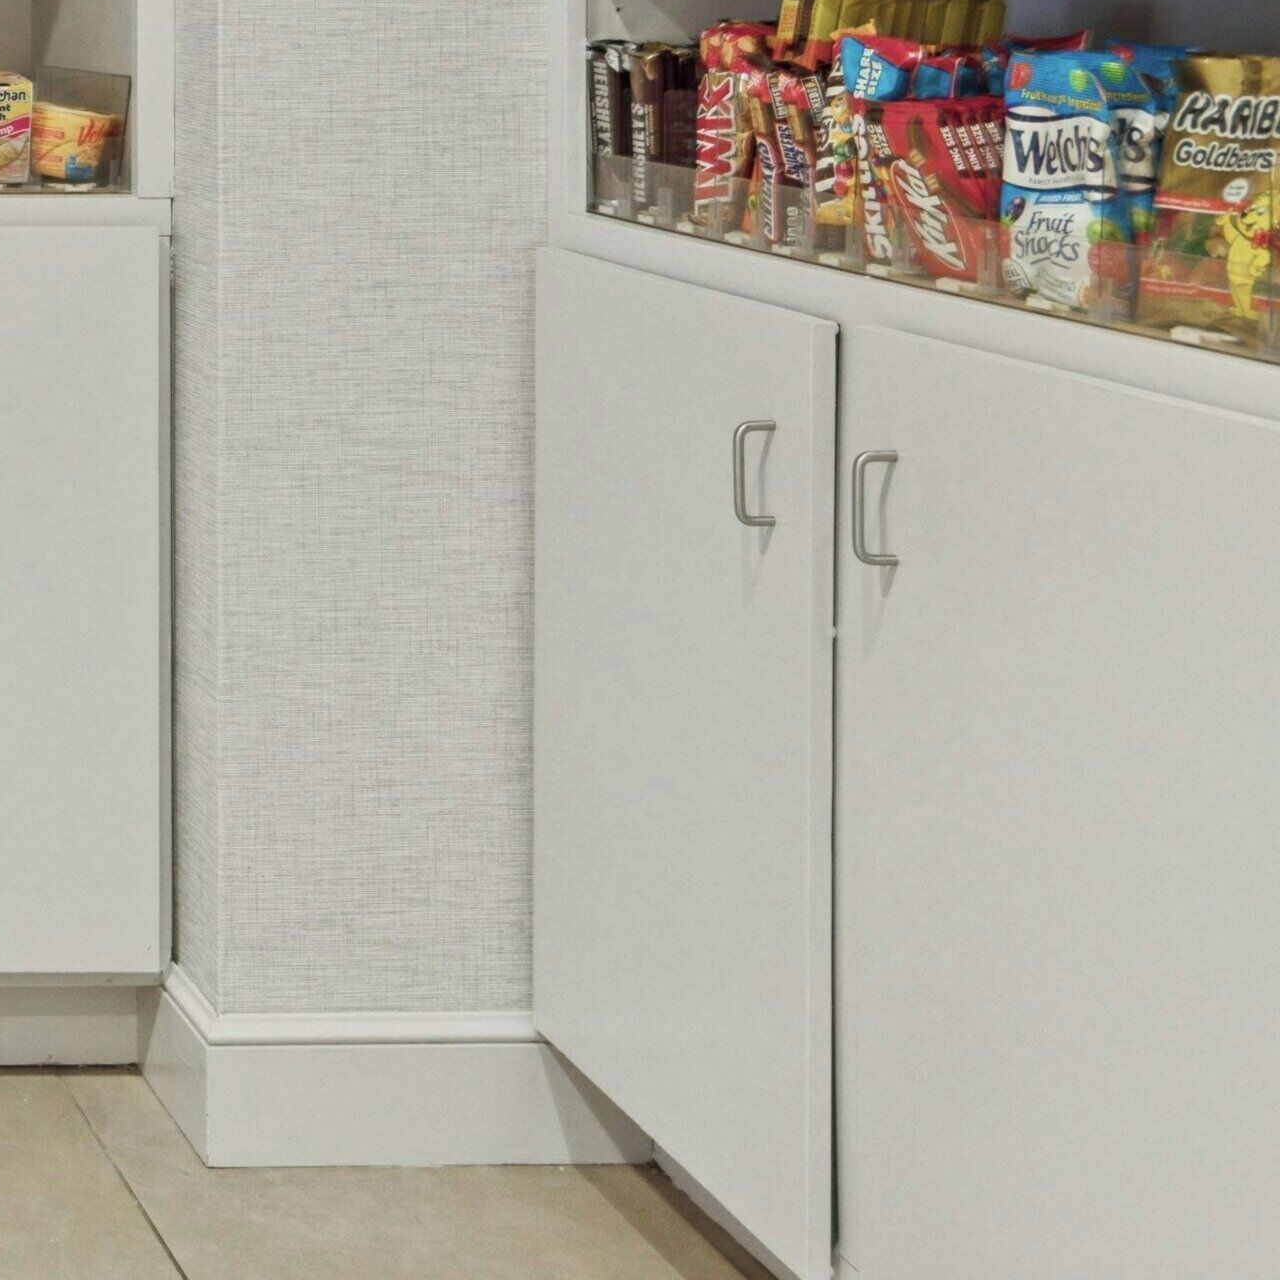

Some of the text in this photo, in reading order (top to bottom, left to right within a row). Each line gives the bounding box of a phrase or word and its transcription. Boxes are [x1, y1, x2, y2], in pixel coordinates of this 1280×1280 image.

[854, 47, 874, 99] SHARE
[865, 61, 883, 95] SIZE
[593, 60, 613, 157] HERSHEY'S
[1175, 93, 1280, 138] HARIB
[940, 126, 966, 171] KING SIZE
[956, 126, 982, 171] KING SIZE
[1010, 124, 1104, 175] Welch's
[1174, 140, 1275, 171] Goldbears
[1027, 211, 1076, 235] Fruit
[1014, 231, 1080, 261] Snacks
